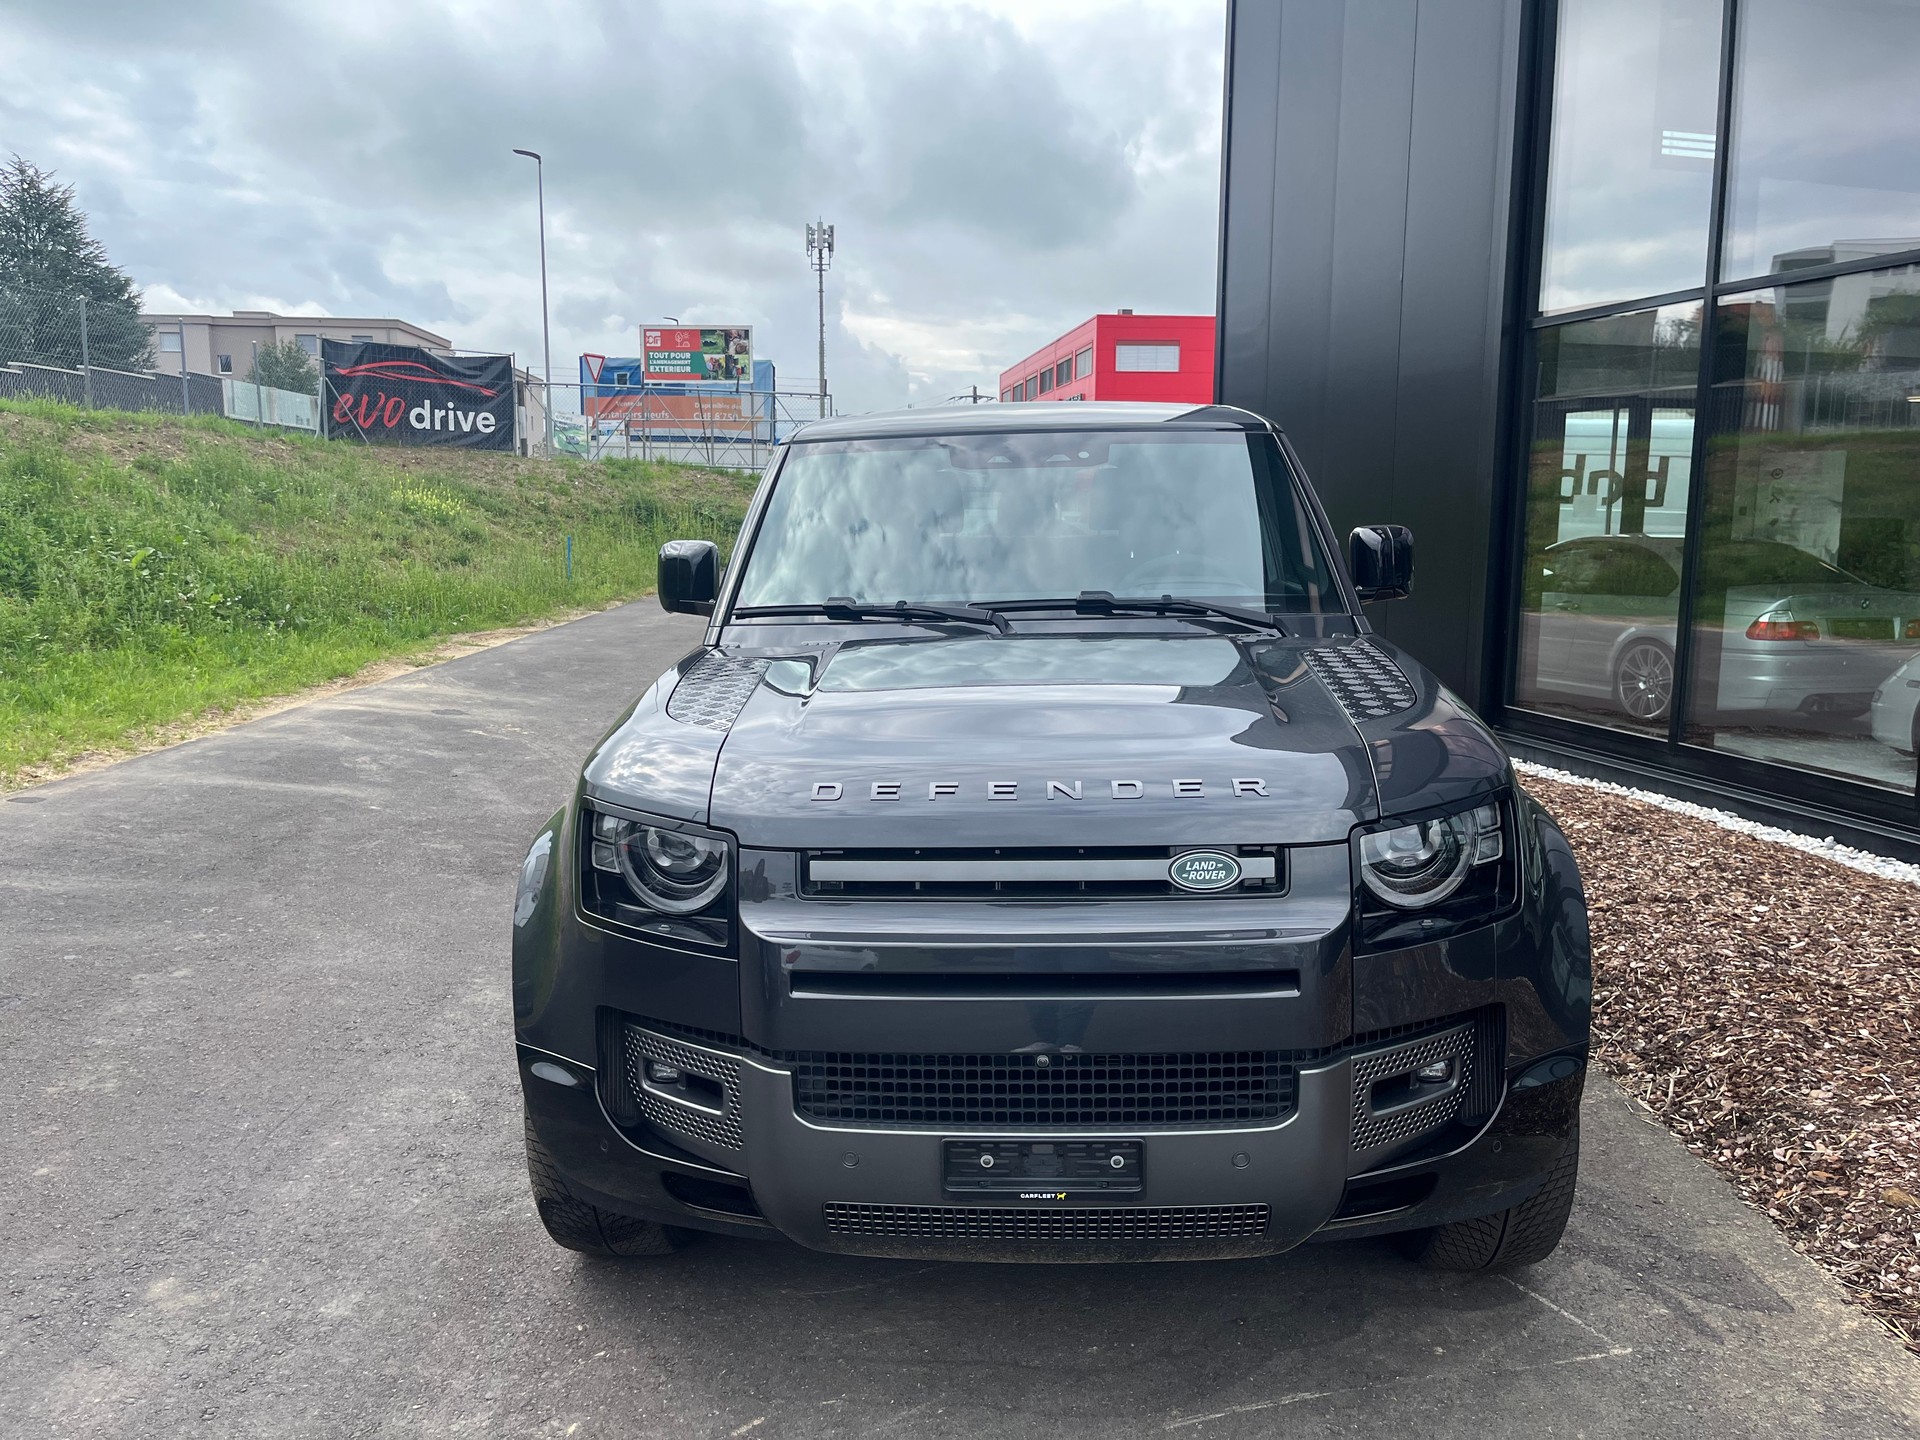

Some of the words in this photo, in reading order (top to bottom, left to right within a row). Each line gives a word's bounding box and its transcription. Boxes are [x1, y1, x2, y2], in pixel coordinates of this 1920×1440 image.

[648, 352, 669, 360] TOUT
[670, 352, 691, 360] POUR
[649, 365, 691, 373] EXTERIEUR
[333, 392, 406, 429] evo
[409, 399, 496, 434] drive
[811, 777, 1270, 802] DEFENDER
